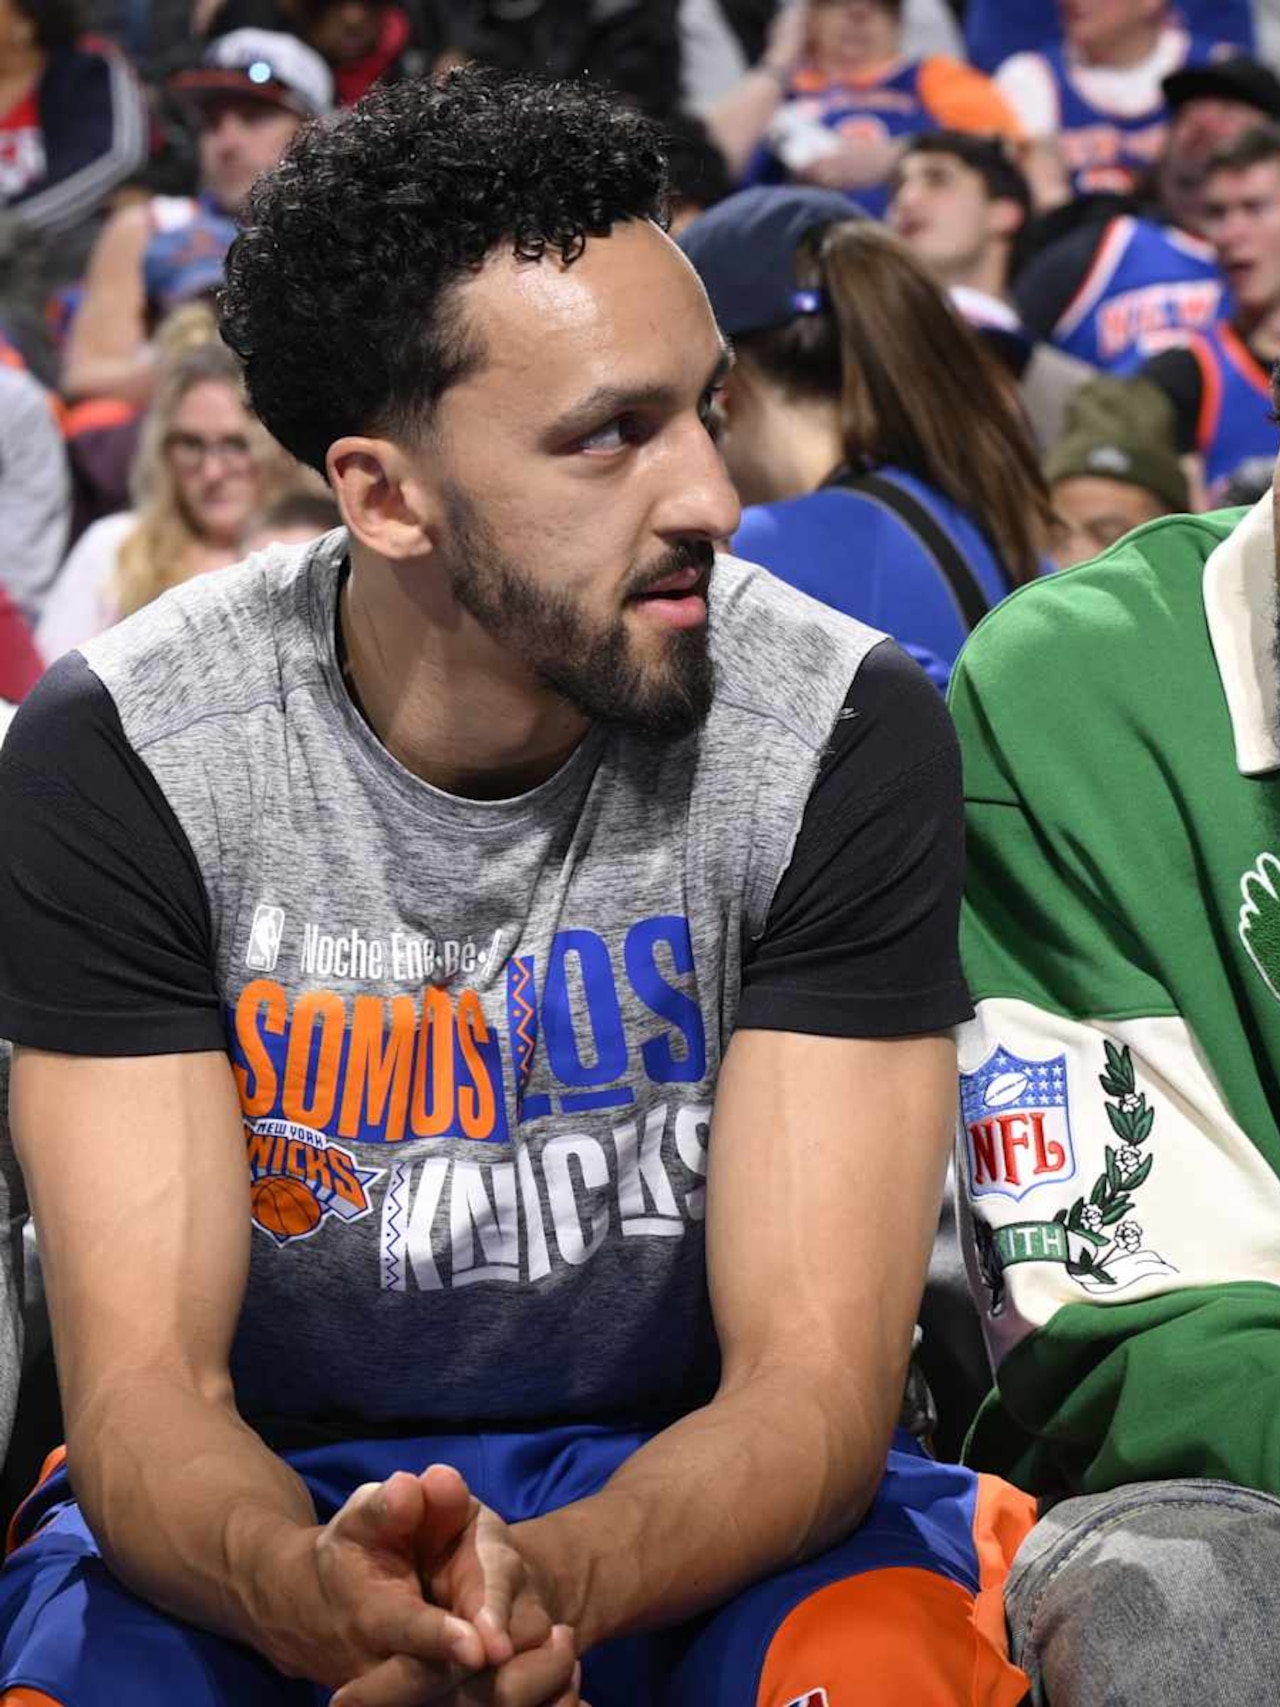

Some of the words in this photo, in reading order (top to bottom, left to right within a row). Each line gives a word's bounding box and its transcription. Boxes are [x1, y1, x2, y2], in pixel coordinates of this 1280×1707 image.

[301, 923, 383, 979] Noche
[233, 978, 495, 1142] SOMOS
[507, 915, 706, 1124] LOS
[243, 1125, 368, 1210] NICKS
[256, 1122, 287, 1135] NEW
[289, 1126, 324, 1149] YORK
[967, 1112, 1065, 1186] NFL
[380, 1104, 712, 1291] KNICKS
